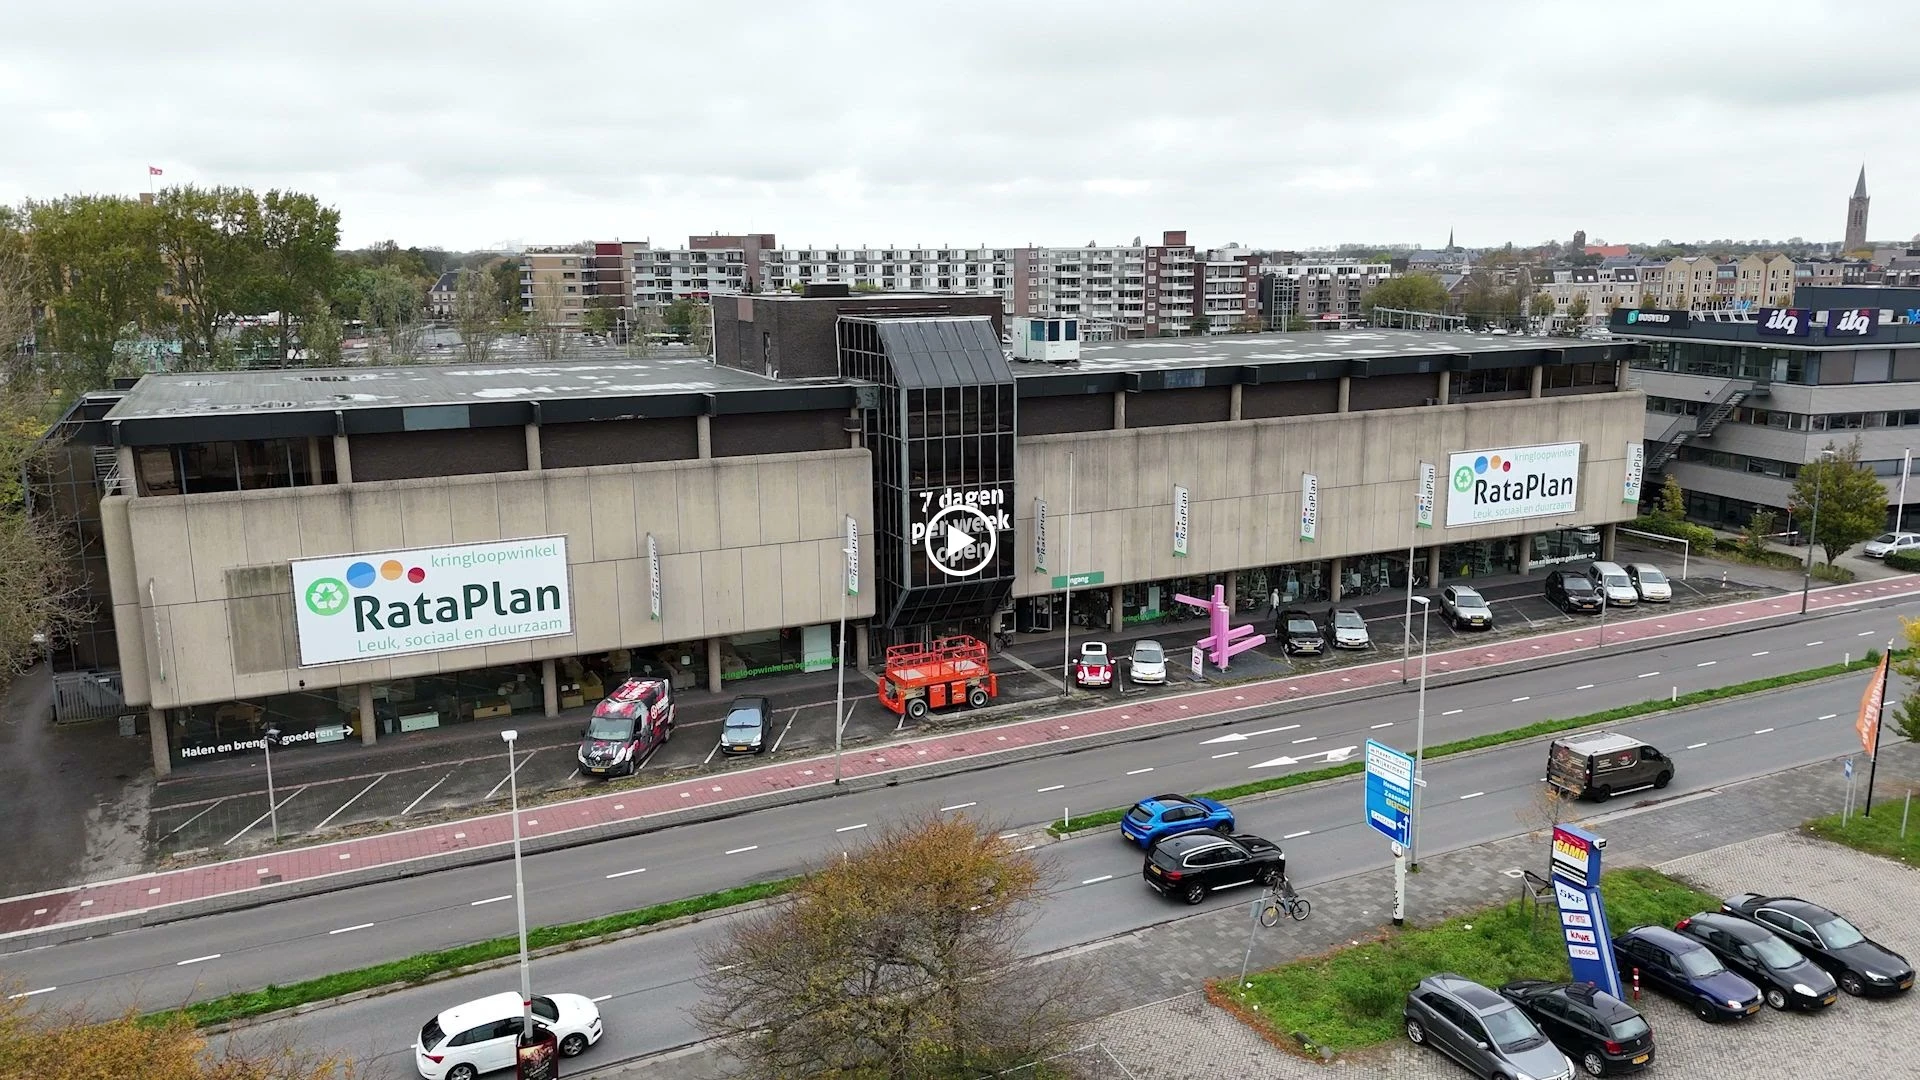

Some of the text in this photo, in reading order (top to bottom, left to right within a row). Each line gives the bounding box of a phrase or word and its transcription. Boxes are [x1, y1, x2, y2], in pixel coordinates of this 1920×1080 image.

[1514, 447, 1576, 463] kringloopwinkel
[919, 487, 1004, 513] 7 dagen
[1474, 473, 1573, 505] RataPlan
[1495, 504, 1522, 517] sociaal
[1523, 504, 1534, 514] en
[1535, 500, 1572, 513] duurzaam
[431, 544, 558, 569] kringloopwinkel
[1067, 576, 1089, 585] ngang
[353, 581, 561, 633] RataPlan
[358, 617, 563, 653] Leuk, sociaal en duurzaam
[182, 744, 216, 758] Halen
[217, 743, 232, 753] en
[281, 728, 334, 746] goederen
[1560, 889, 1584, 903] SKF
